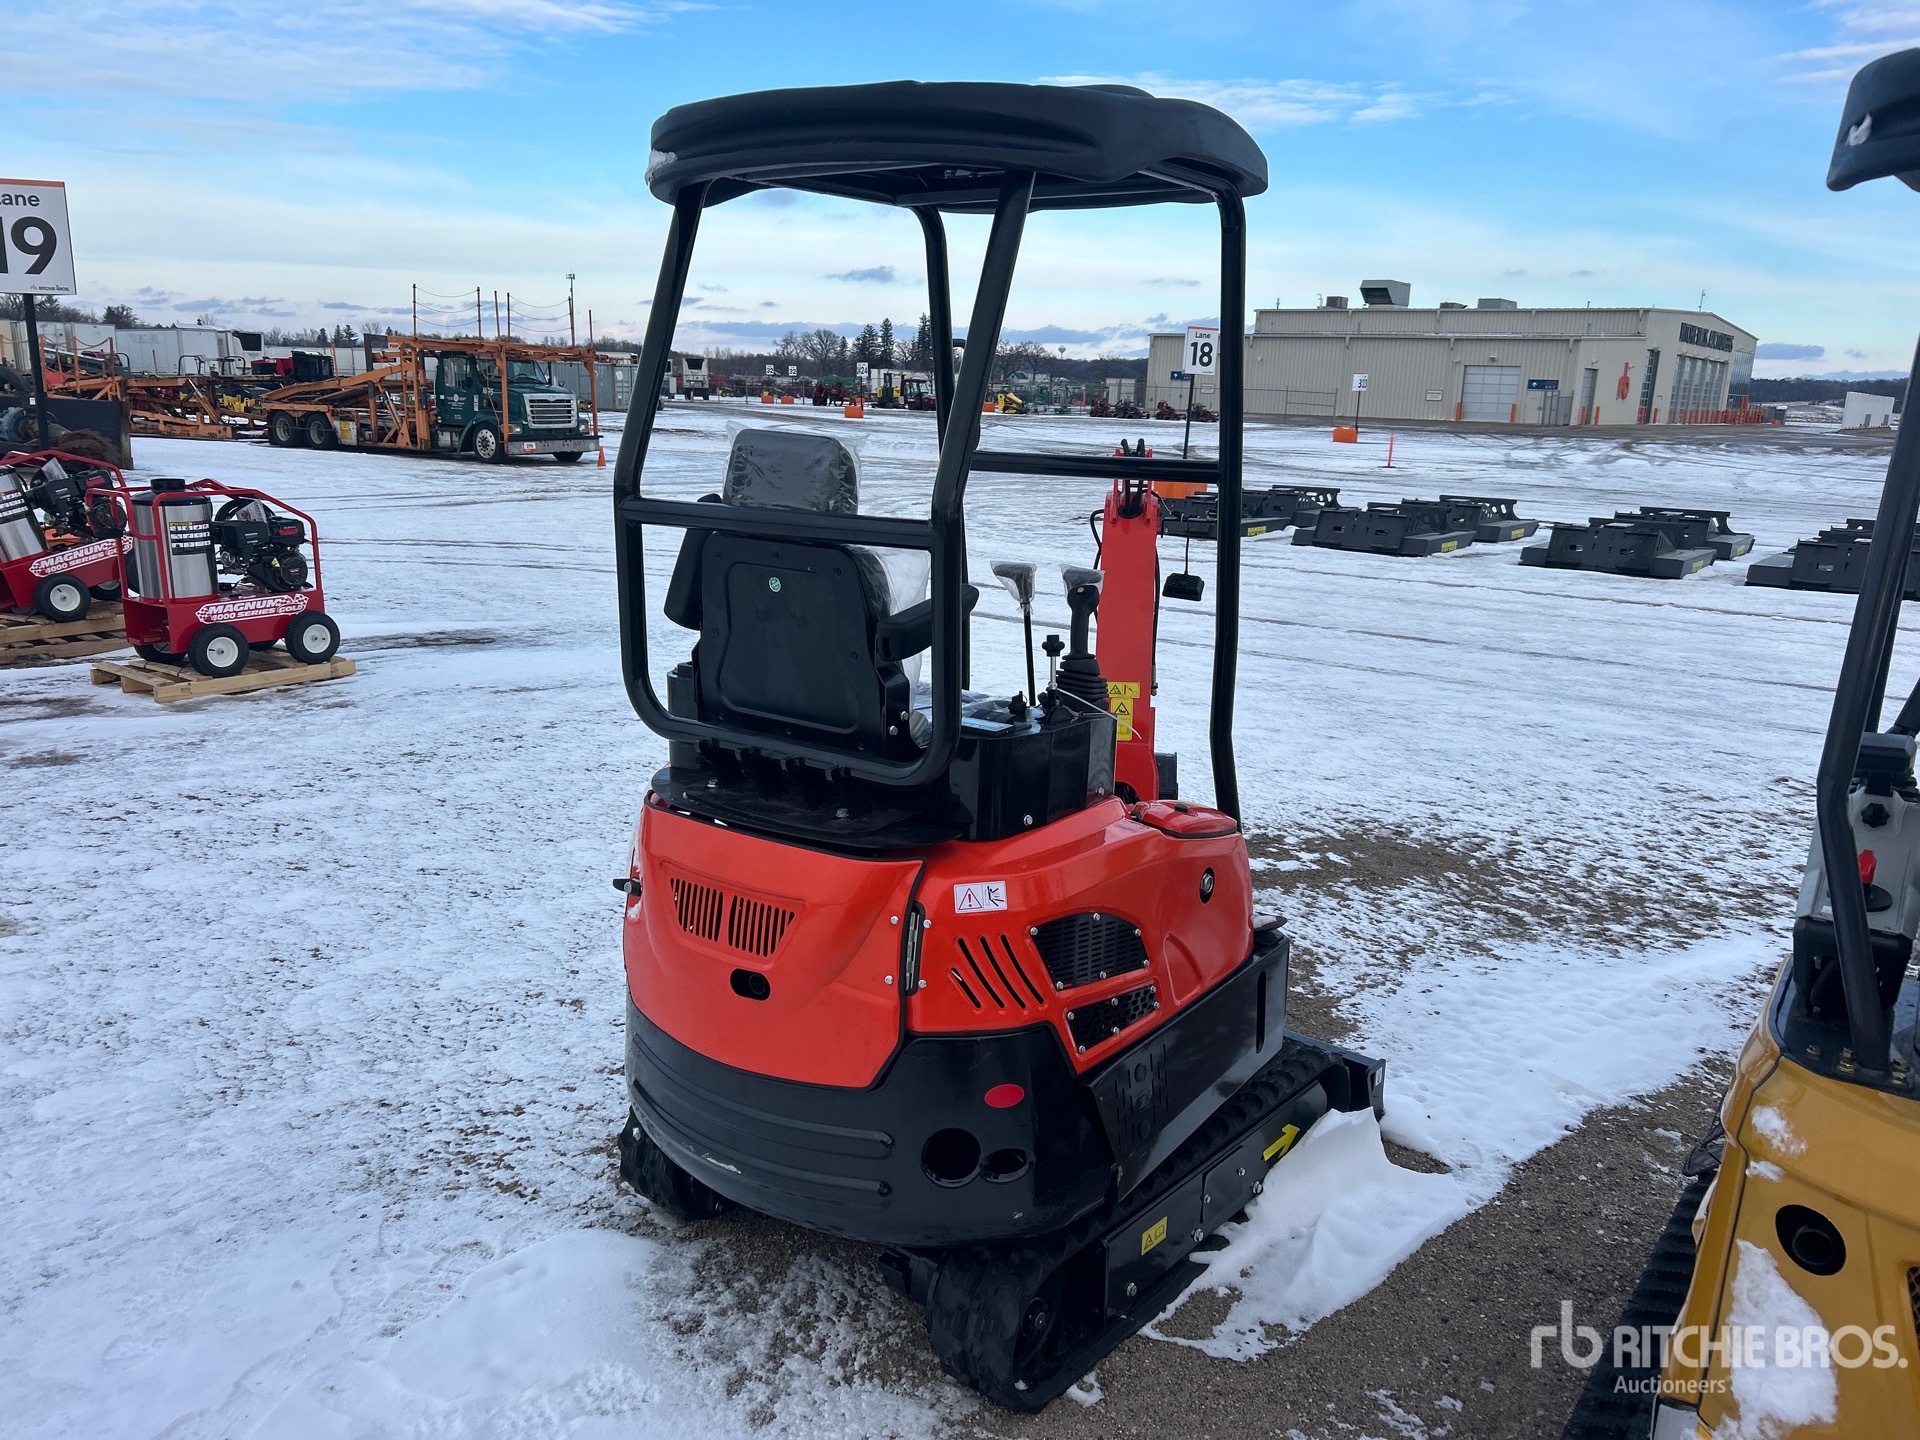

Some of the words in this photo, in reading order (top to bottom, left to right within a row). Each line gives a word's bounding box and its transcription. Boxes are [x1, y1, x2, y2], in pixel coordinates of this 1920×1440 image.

[0, 193, 40, 207] ane
[1195, 331, 1211, 339] Lane
[1190, 341, 1213, 367] 18
[40, 542, 106, 568] MAGNUM
[45, 563, 68, 574] 4000
[68, 552, 104, 567] SERIES
[208, 598, 281, 614] MAGNUM
[211, 612, 235, 621] 4000
[237, 607, 275, 618] SERIES
[278, 604, 303, 613] GOLD
